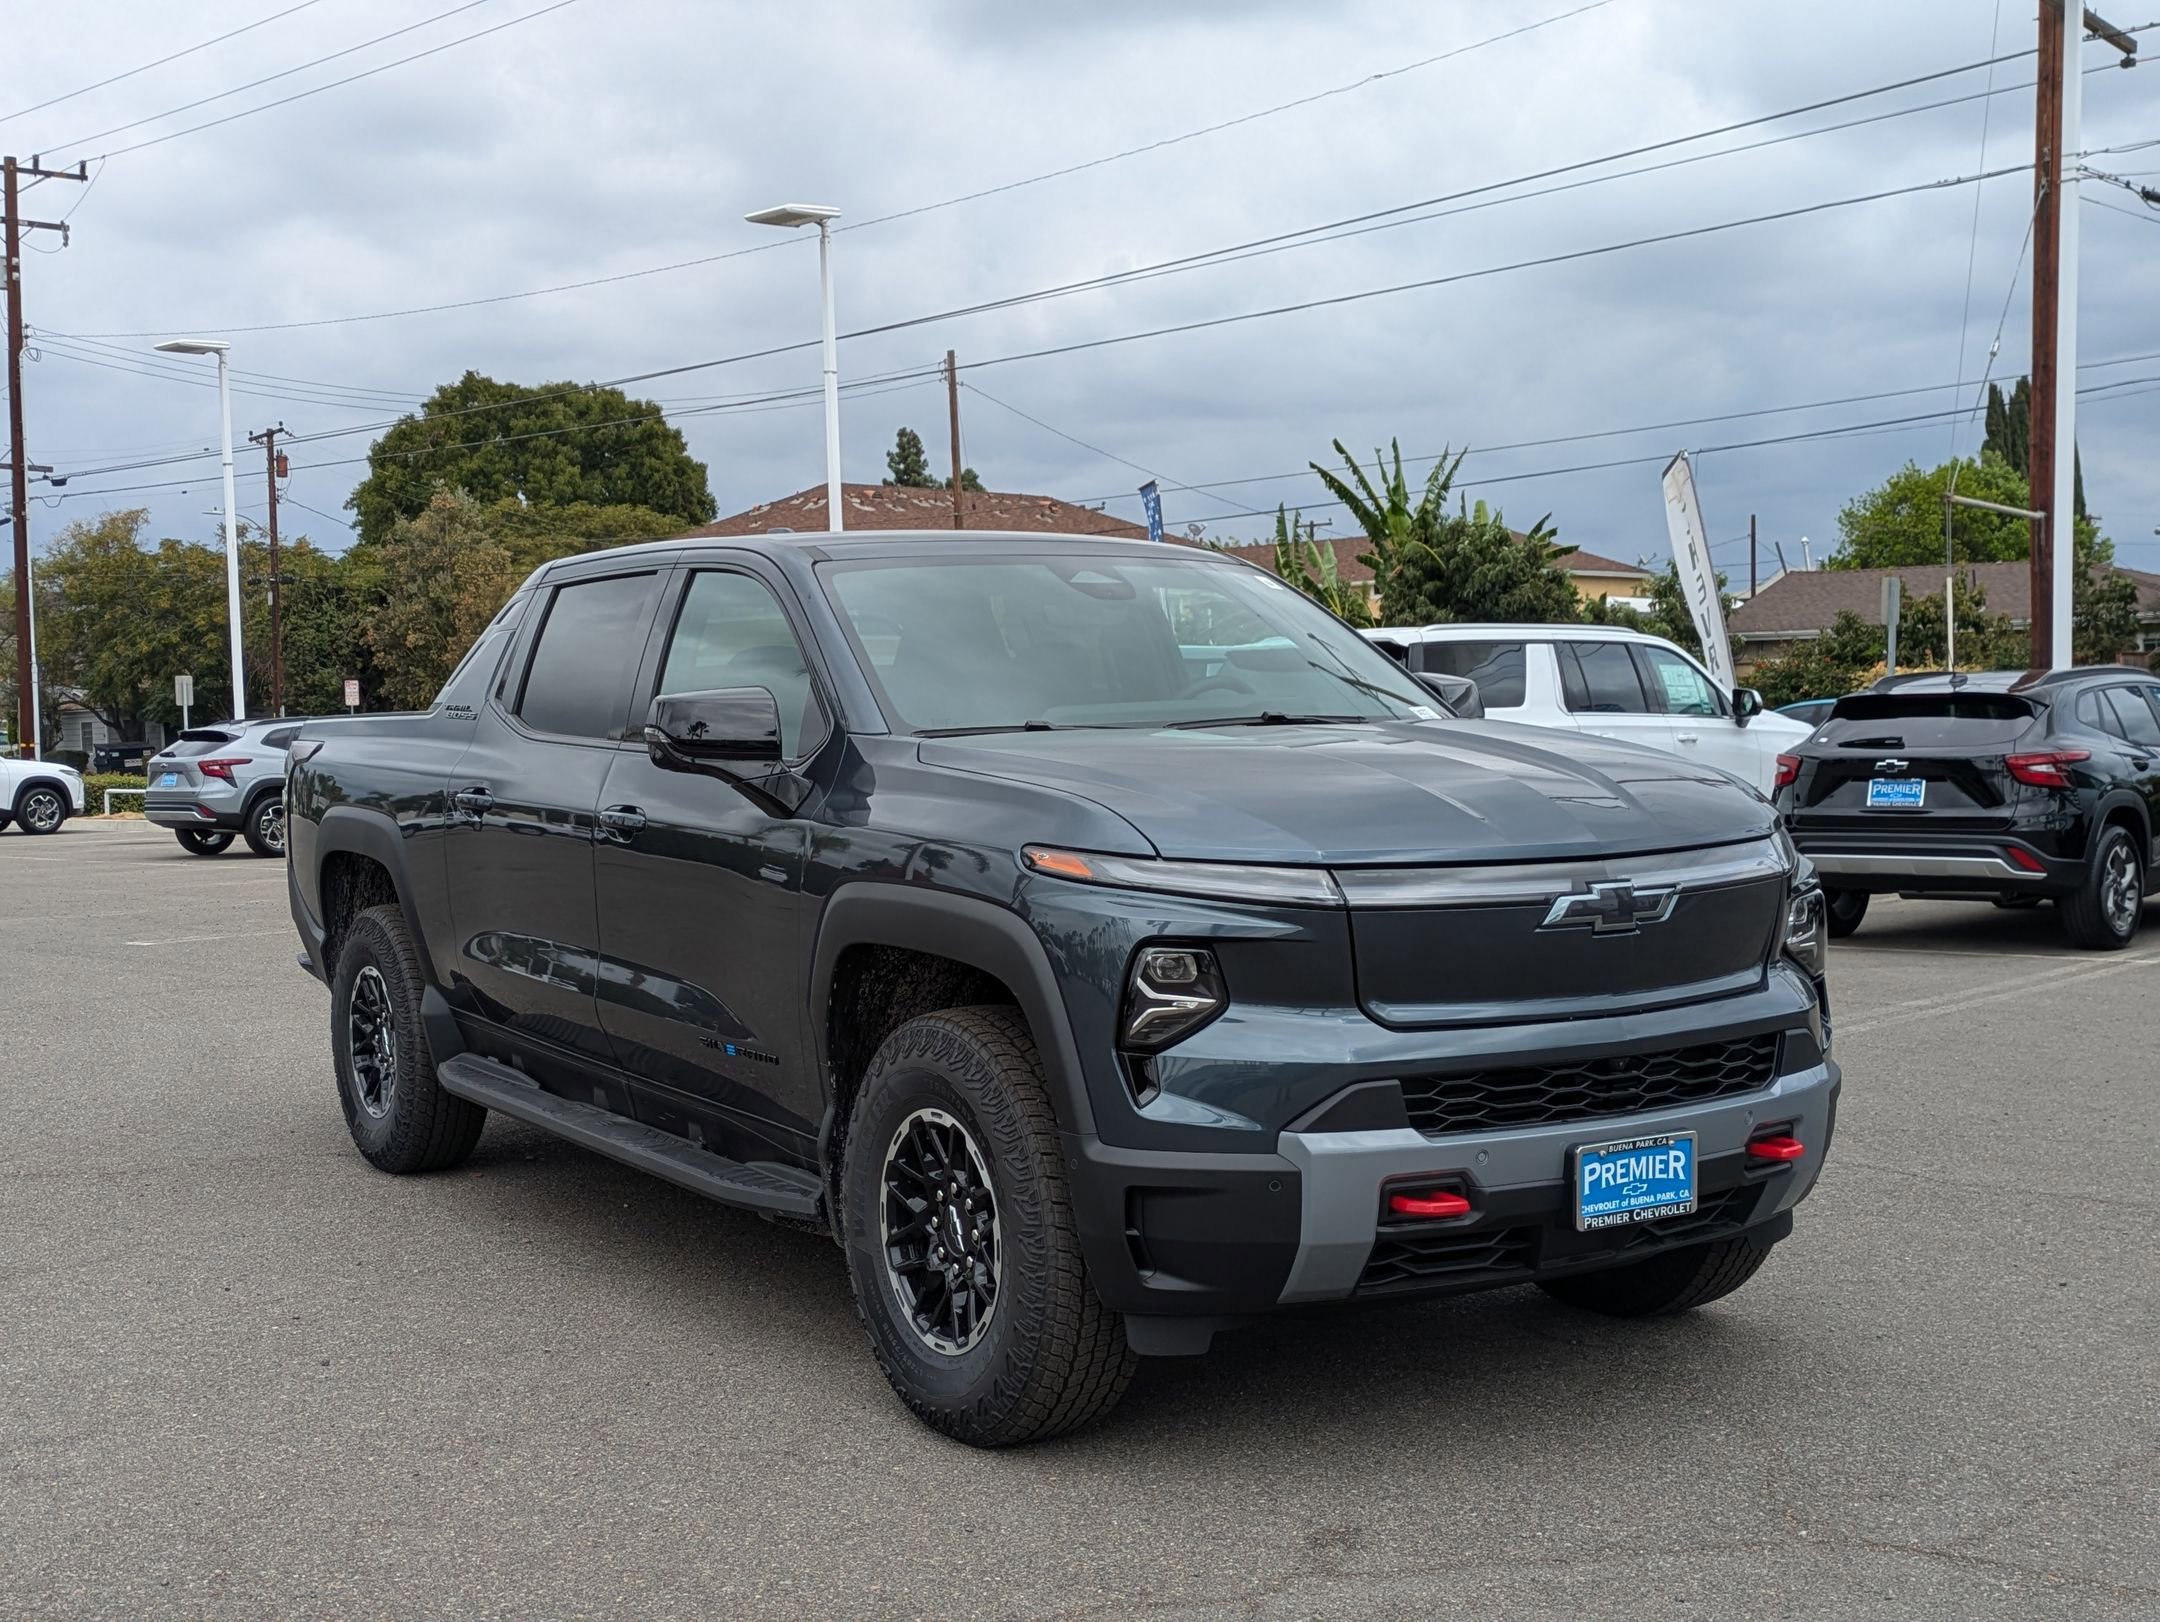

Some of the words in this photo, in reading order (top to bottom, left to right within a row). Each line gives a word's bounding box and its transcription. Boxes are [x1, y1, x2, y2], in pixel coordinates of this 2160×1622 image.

[446, 711, 478, 721] BOSS
[1872, 783, 1921, 796] PREMIER
[1608, 1143, 1634, 1153] BUENA
[1657, 1137, 1667, 1146] CA
[1583, 1150, 1686, 1196] PREMIER
[1621, 1197, 1630, 1207] of
[1630, 1195, 1655, 1206] BUENA
[1679, 1189, 1690, 1198] CA
[1584, 1212, 1630, 1229] PREMIER
[1633, 1202, 1692, 1221] CHEVROLET
